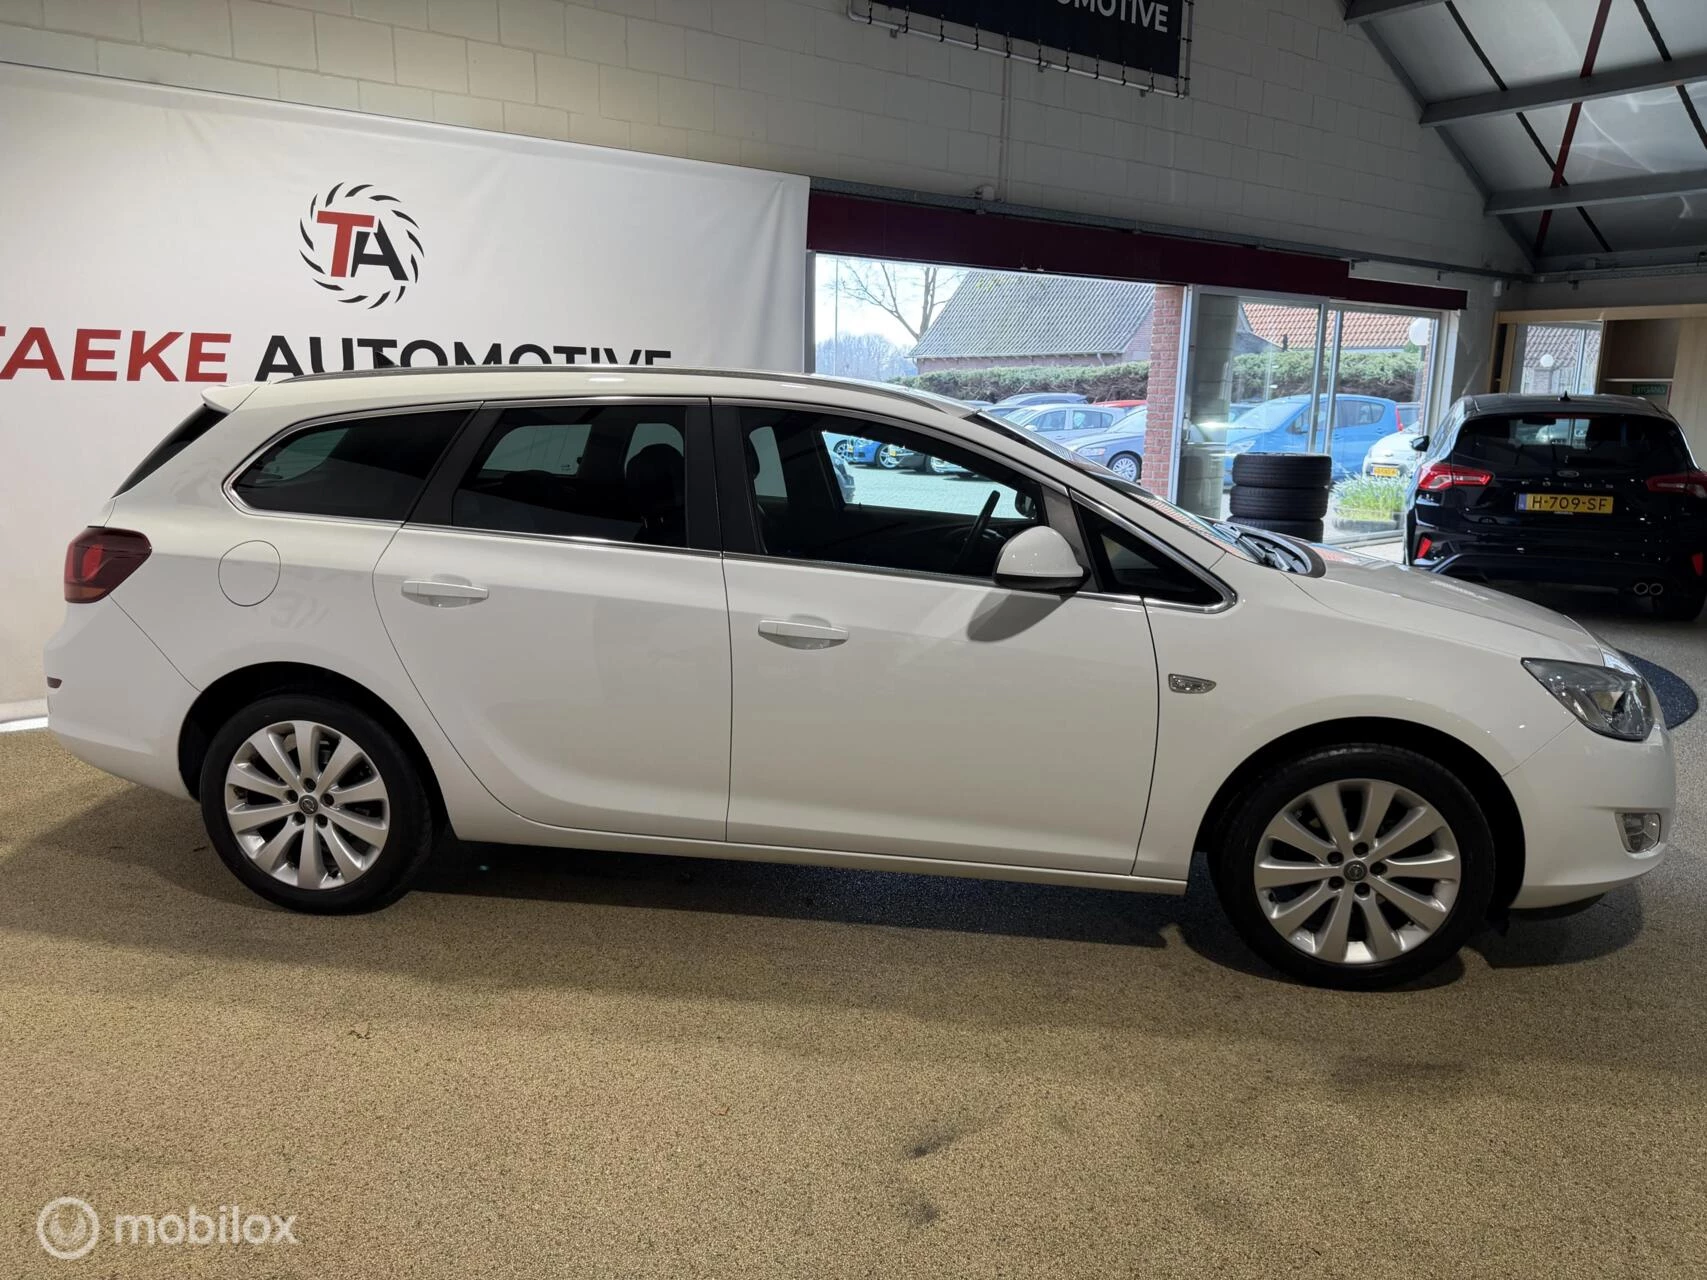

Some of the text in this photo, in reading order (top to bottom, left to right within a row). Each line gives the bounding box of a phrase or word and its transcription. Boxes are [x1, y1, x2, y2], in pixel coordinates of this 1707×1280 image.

[1056, 0, 1169, 33] OTIVE
[316, 210, 409, 281] TA
[0, 326, 232, 383] AEKE
[1531, 495, 1608, 512] H-709-SF
